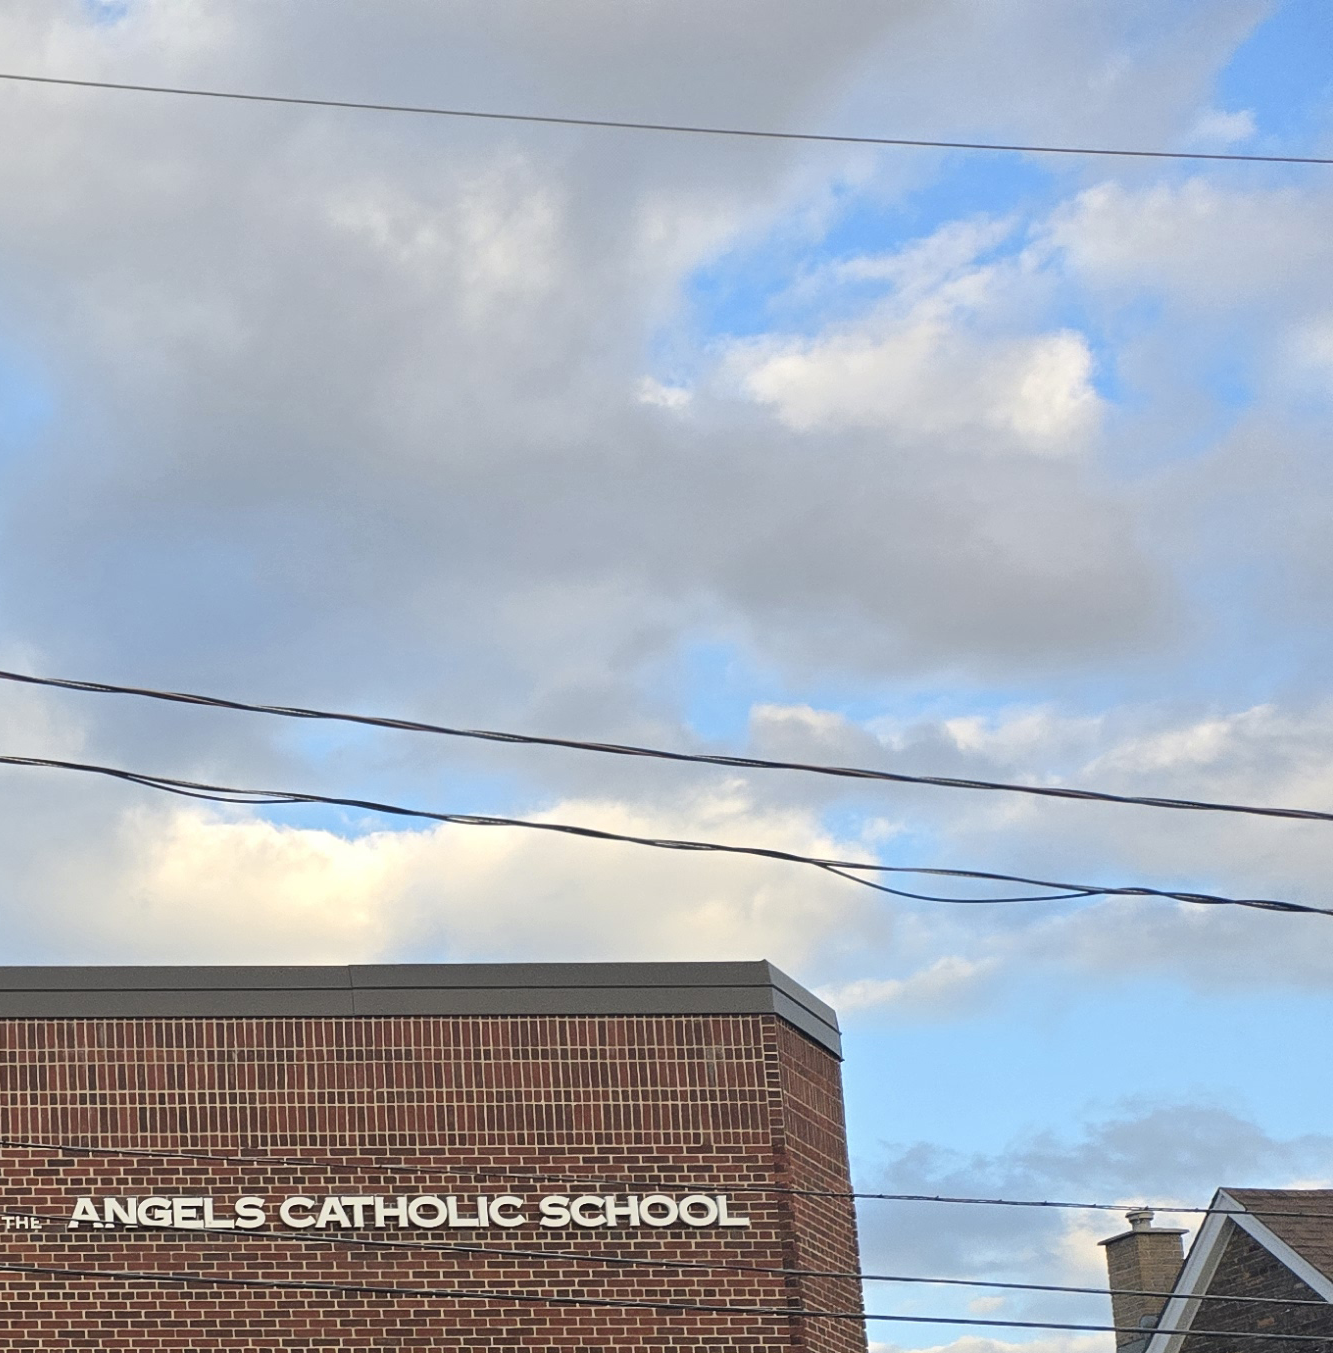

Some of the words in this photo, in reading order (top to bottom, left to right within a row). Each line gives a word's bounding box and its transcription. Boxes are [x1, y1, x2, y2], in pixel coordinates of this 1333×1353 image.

[1, 1214, 43, 1231] THE
[66, 1196, 267, 1230] ANGELS
[278, 1195, 528, 1229] CATHOLIC
[538, 1194, 751, 1228] SCHOOL
